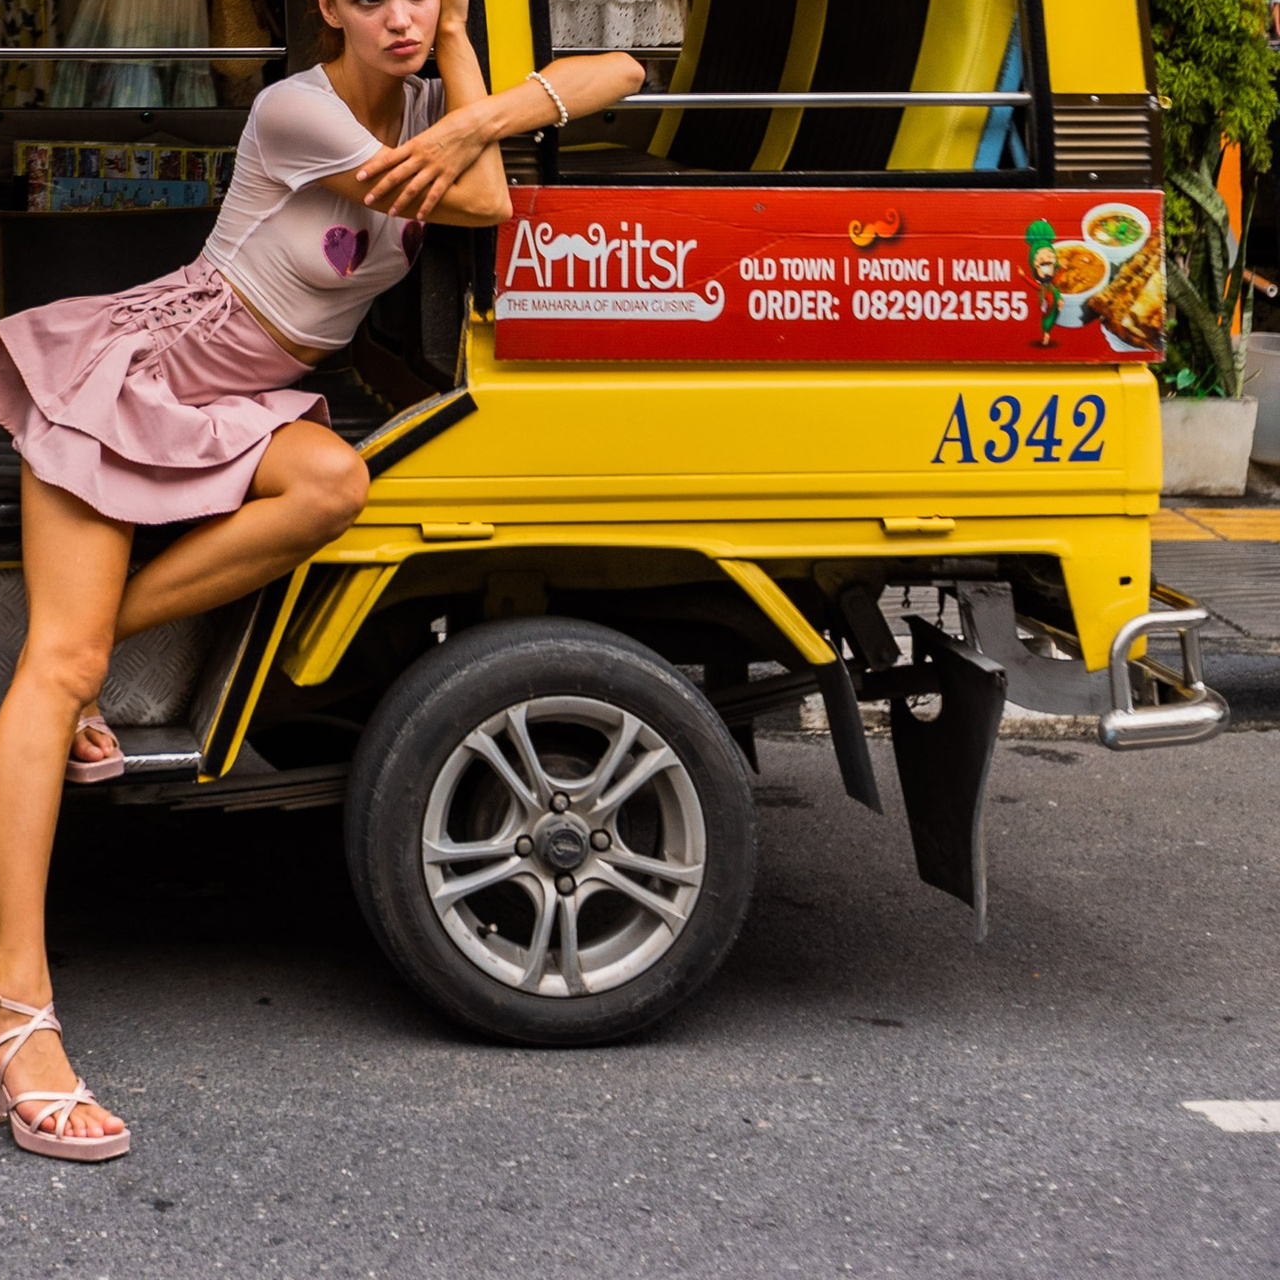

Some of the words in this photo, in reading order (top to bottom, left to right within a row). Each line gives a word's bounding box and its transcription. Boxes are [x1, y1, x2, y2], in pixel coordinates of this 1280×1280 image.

[505, 219, 698, 290] Amritsr
[739, 257, 777, 281] OLD
[779, 258, 836, 281] TOWN
[858, 258, 930, 282] PATONG
[952, 259, 1011, 282] KALIM
[506, 298, 528, 312] THE
[531, 298, 592, 312] MAHARAJA
[593, 298, 610, 312] OF
[611, 298, 649, 312] INDIAN
[651, 298, 696, 313] CUISINE
[748, 289, 841, 321] ORDER:
[852, 290, 1029, 321] 0829021555
[931, 393, 1107, 465] A342
